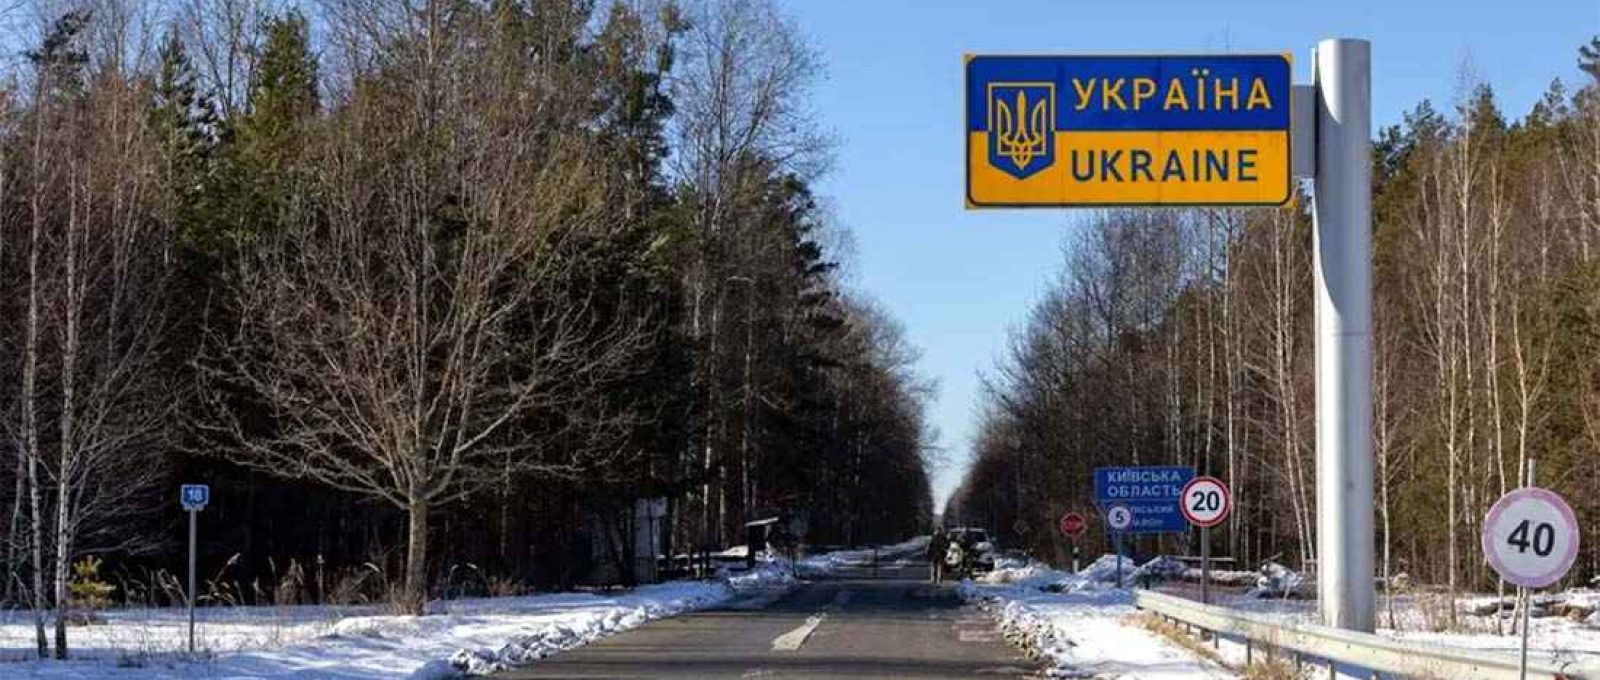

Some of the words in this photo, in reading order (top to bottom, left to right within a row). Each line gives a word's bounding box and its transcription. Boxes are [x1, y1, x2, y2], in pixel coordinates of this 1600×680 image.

[1072, 69, 1272, 110] УКРАЇНА
[1072, 149, 1258, 182] UKRAINE
[1107, 470, 1181, 482] КИЇВСЬКА
[1107, 485, 1180, 498] ОБЛАСТЬ
[1192, 491, 1220, 511] 20
[1115, 511, 1124, 521] 5
[1507, 519, 1555, 557] 40
